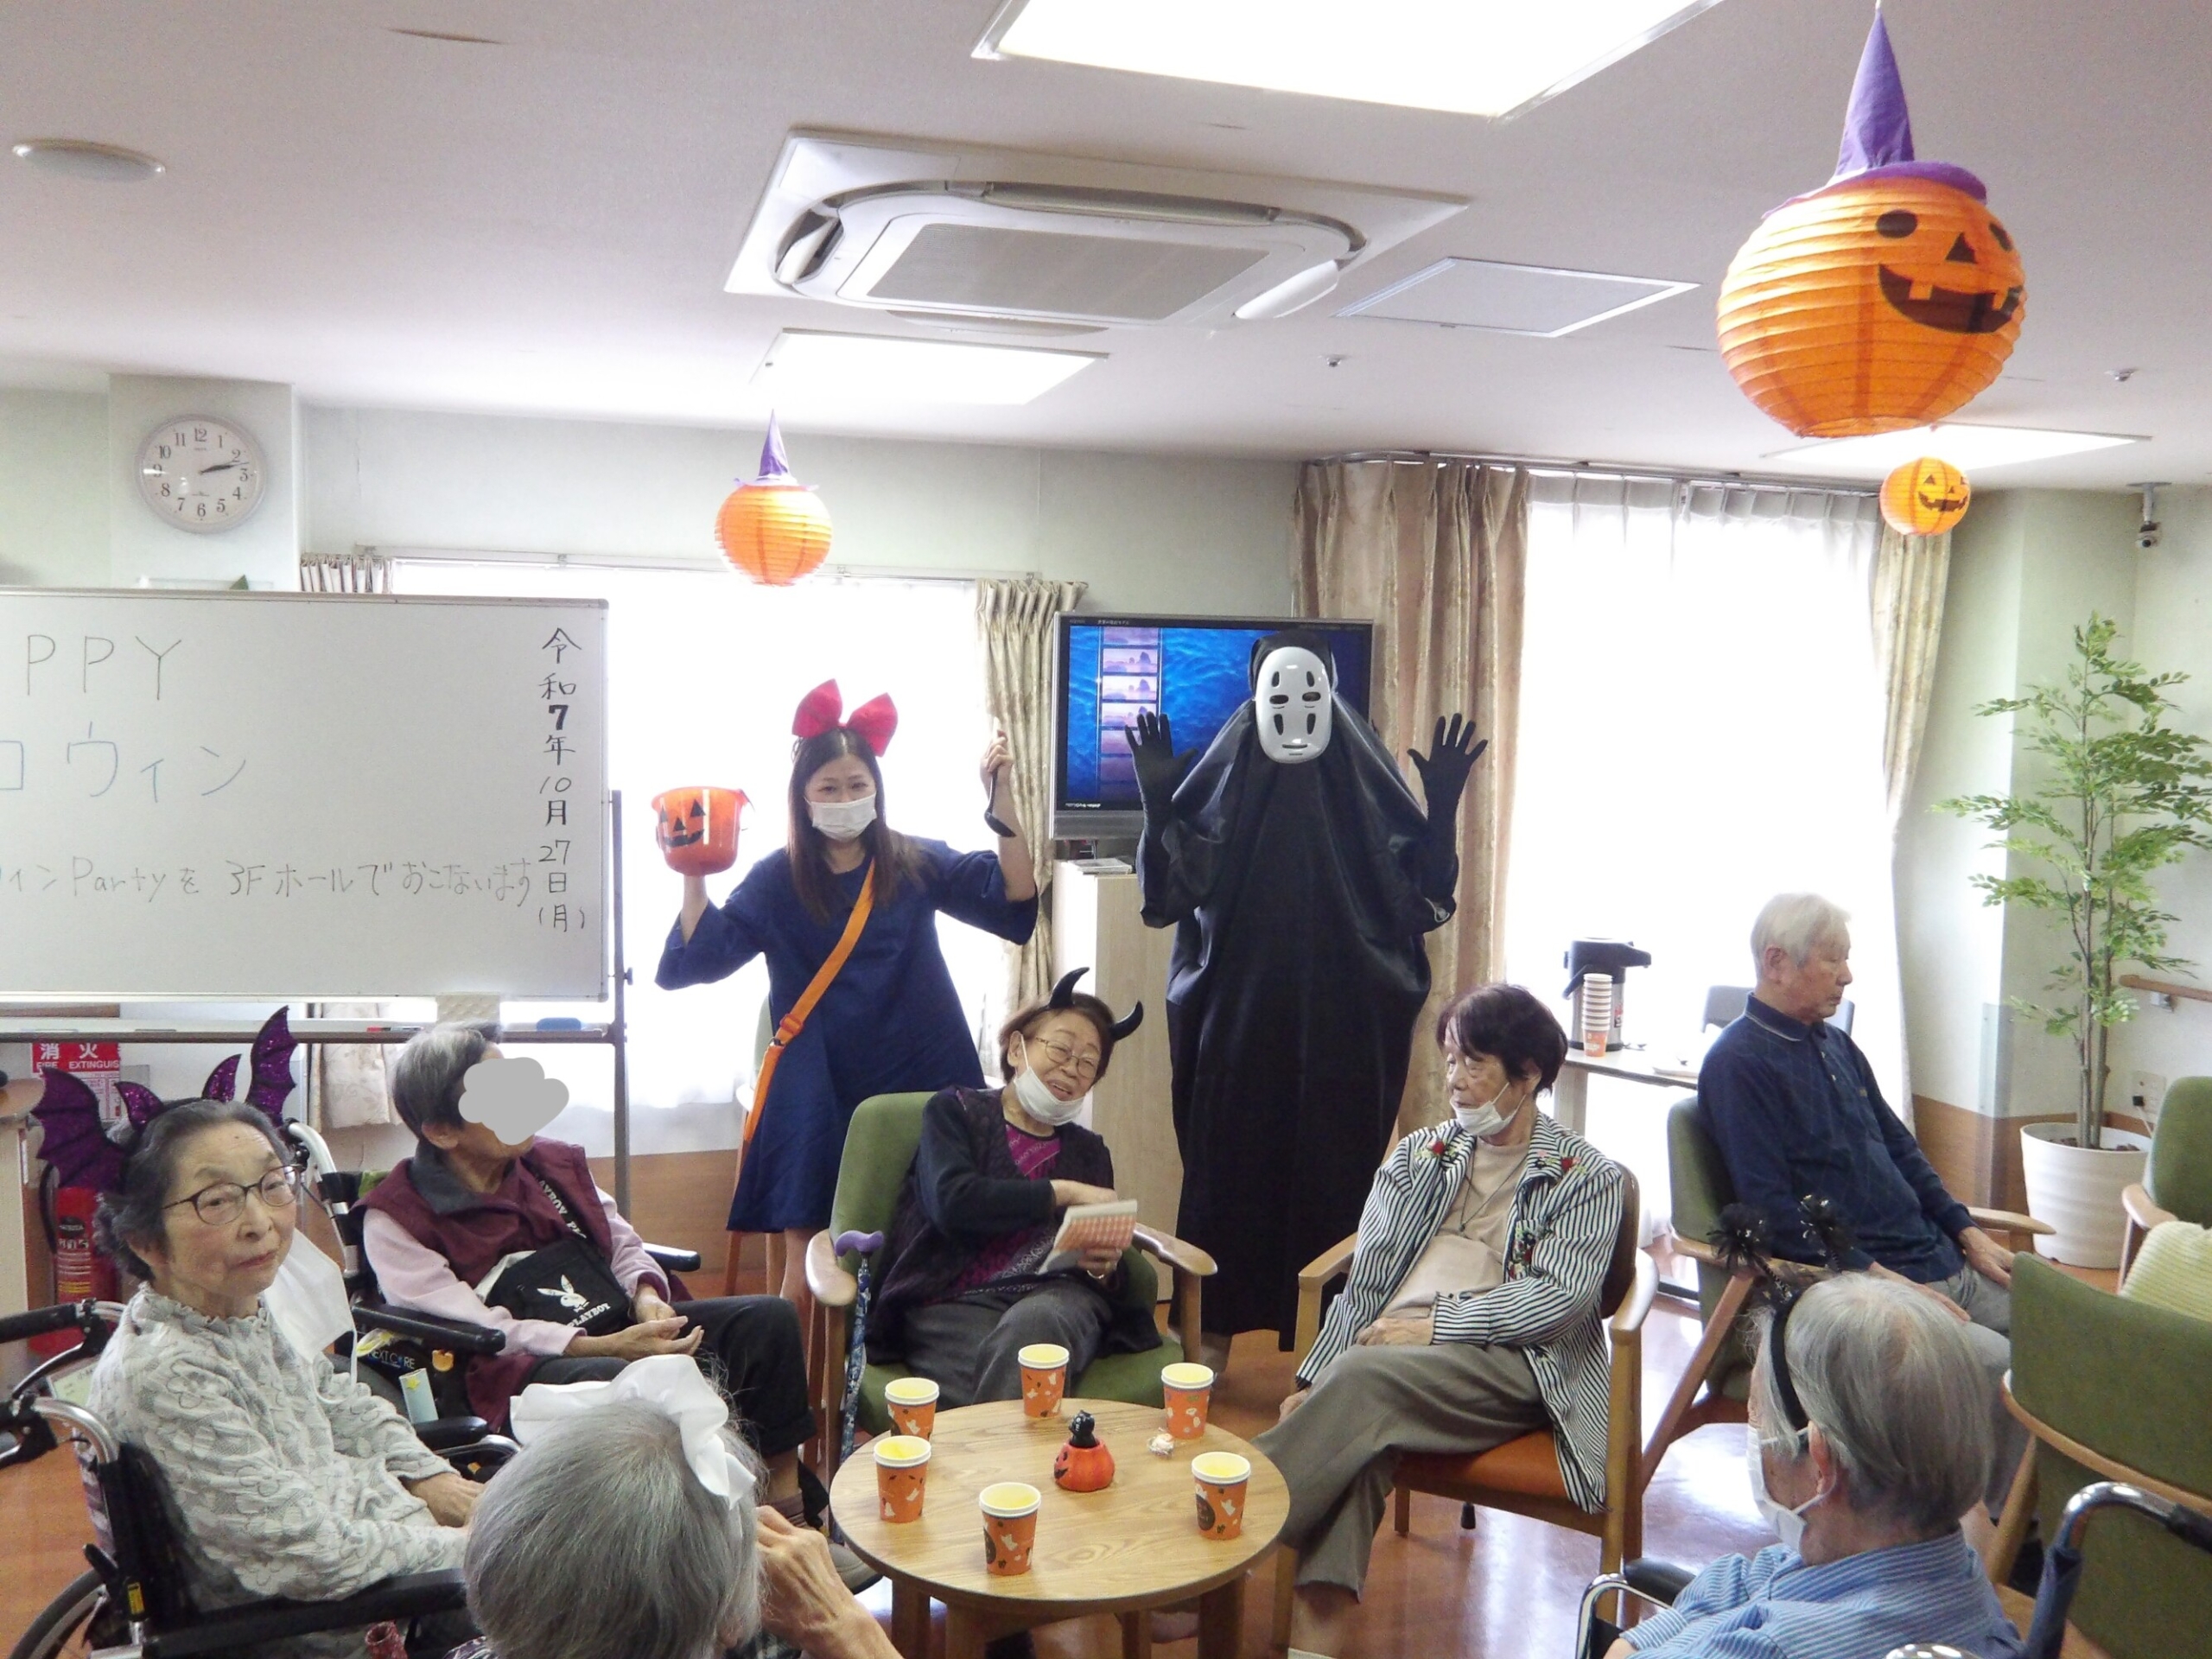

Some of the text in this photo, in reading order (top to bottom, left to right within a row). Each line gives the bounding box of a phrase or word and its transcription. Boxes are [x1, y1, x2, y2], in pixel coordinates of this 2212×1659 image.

[175, 433, 186, 447] 11
[194, 428, 207, 442] 12
[218, 435, 224, 448] 1
[158, 446, 171, 459] 10
[232, 449, 241, 463] 2
[152, 464, 162, 478] 9
[239, 467, 249, 481] 3
[161, 483, 170, 497] 8
[232, 486, 241, 500] 4
[176, 498, 186, 512] 7
[197, 503, 206, 518] 6
[217, 499, 226, 512] 5
[27, 634, 182, 701] PPY
[366, 1348, 390, 1363] EXT
